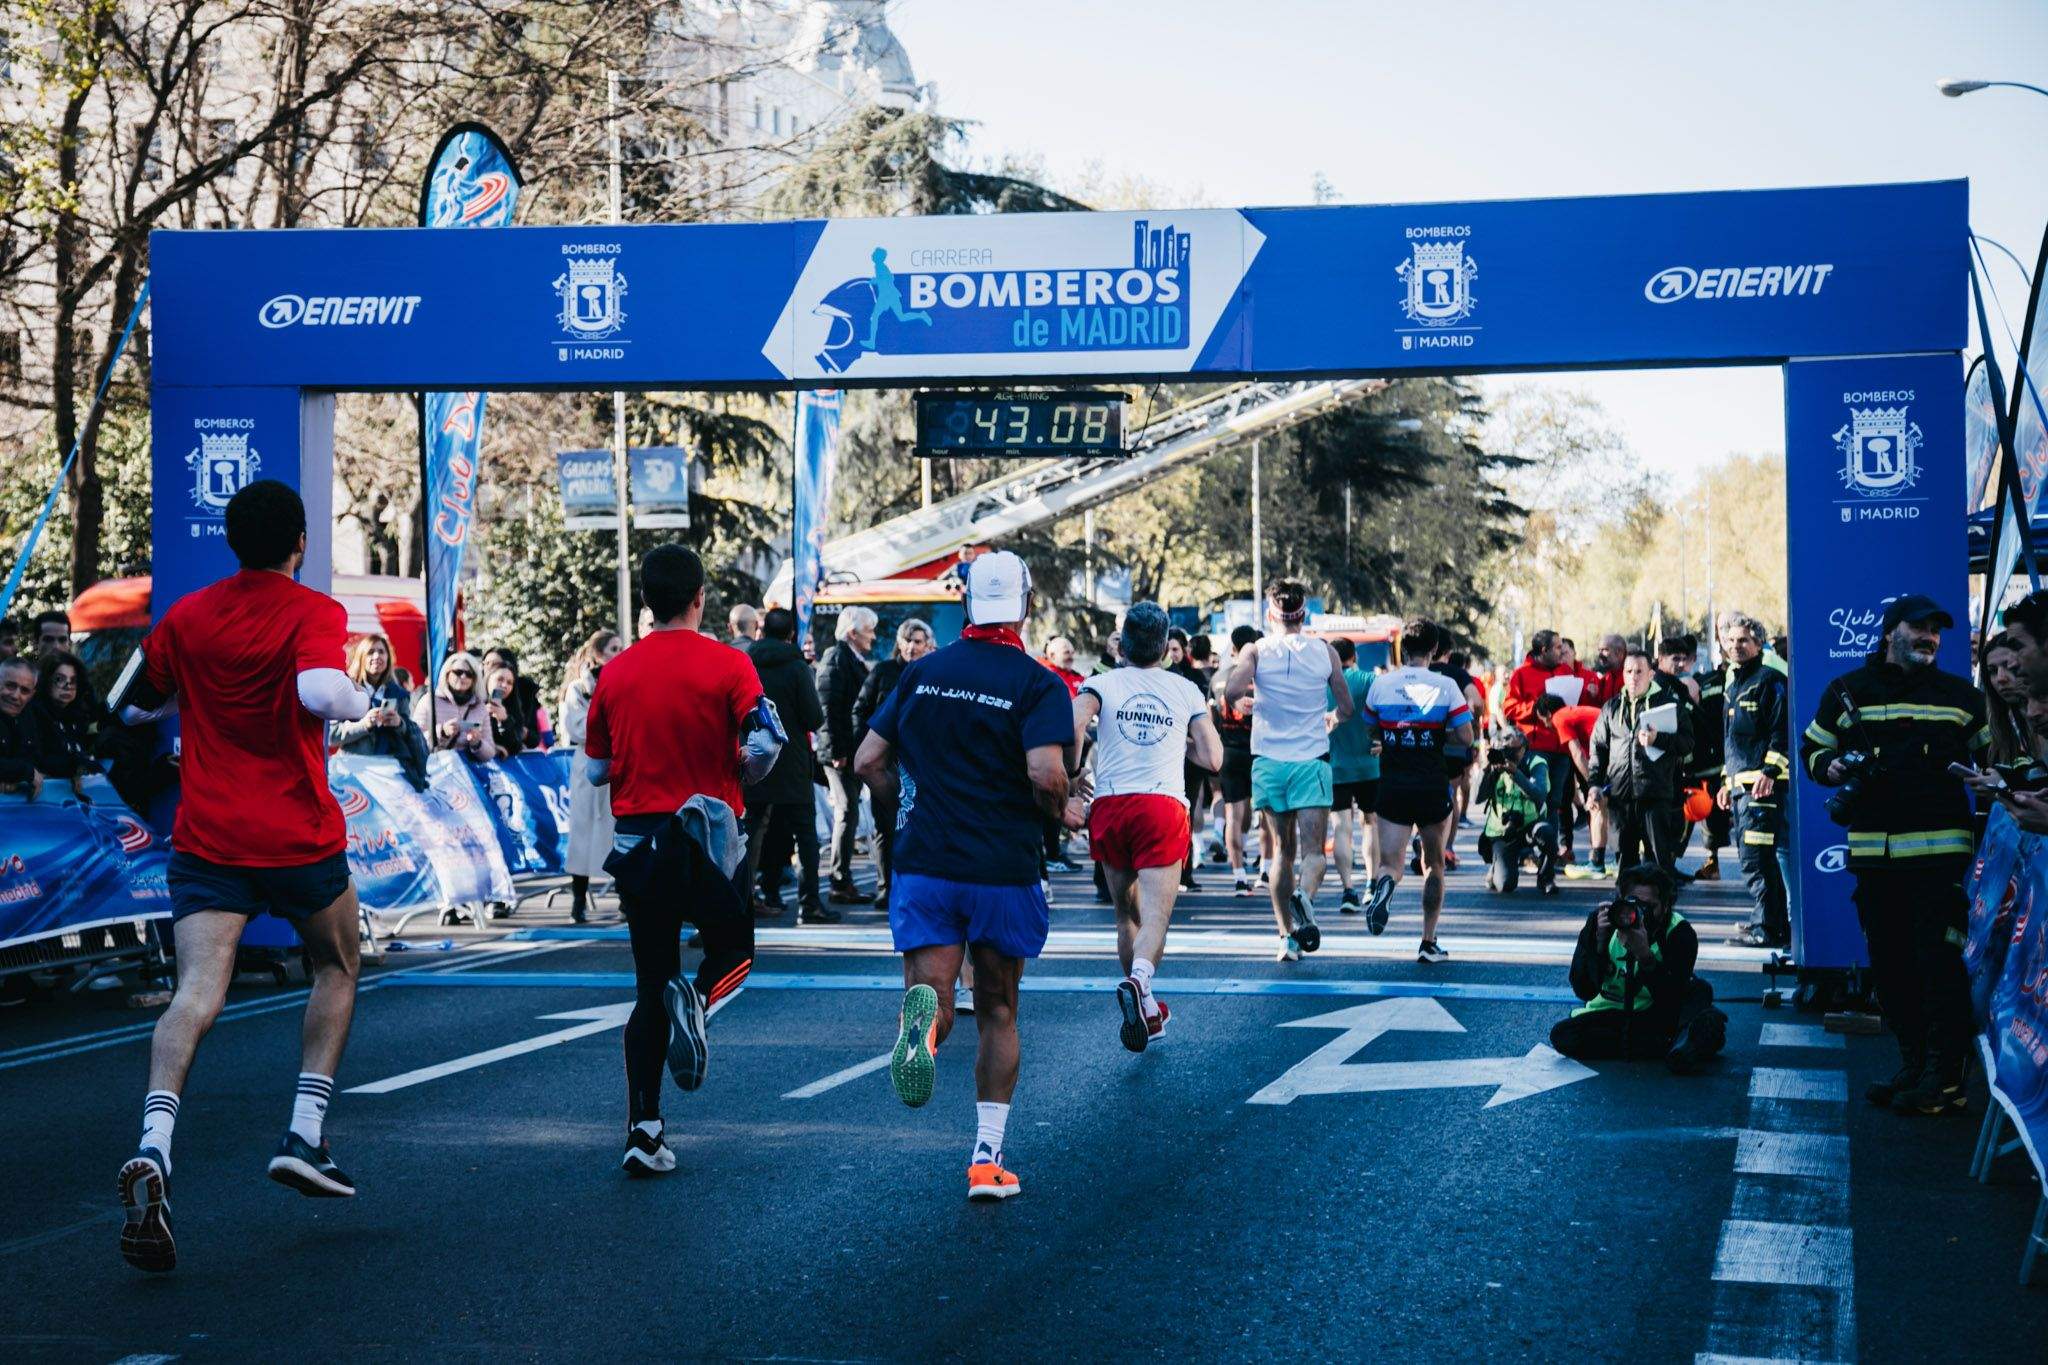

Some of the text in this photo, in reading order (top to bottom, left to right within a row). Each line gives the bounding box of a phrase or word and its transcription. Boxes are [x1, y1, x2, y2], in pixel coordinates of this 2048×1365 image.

[1406, 226, 1471, 238] BOMBEROS
[562, 244, 621, 254] BOMBEROS
[911, 248, 992, 266] CARRERA
[1695, 264, 1834, 299] ENERVIT
[910, 269, 1181, 309] BOMBEROS
[302, 296, 421, 325] ENERVIT
[1013, 306, 1181, 347] de MADRID
[1420, 335, 1473, 347] MADRID
[575, 349, 624, 359] MADRID
[1844, 390, 1915, 403] BOMBEROS
[194, 418, 255, 429] BOMBEROS
[1860, 507, 1920, 519] MADRID
[206, 525, 228, 536] MA
[1829, 608, 1876, 627] Club
[941, 688, 976, 701] JUAN
[1116, 710, 1173, 727] RUNNING
